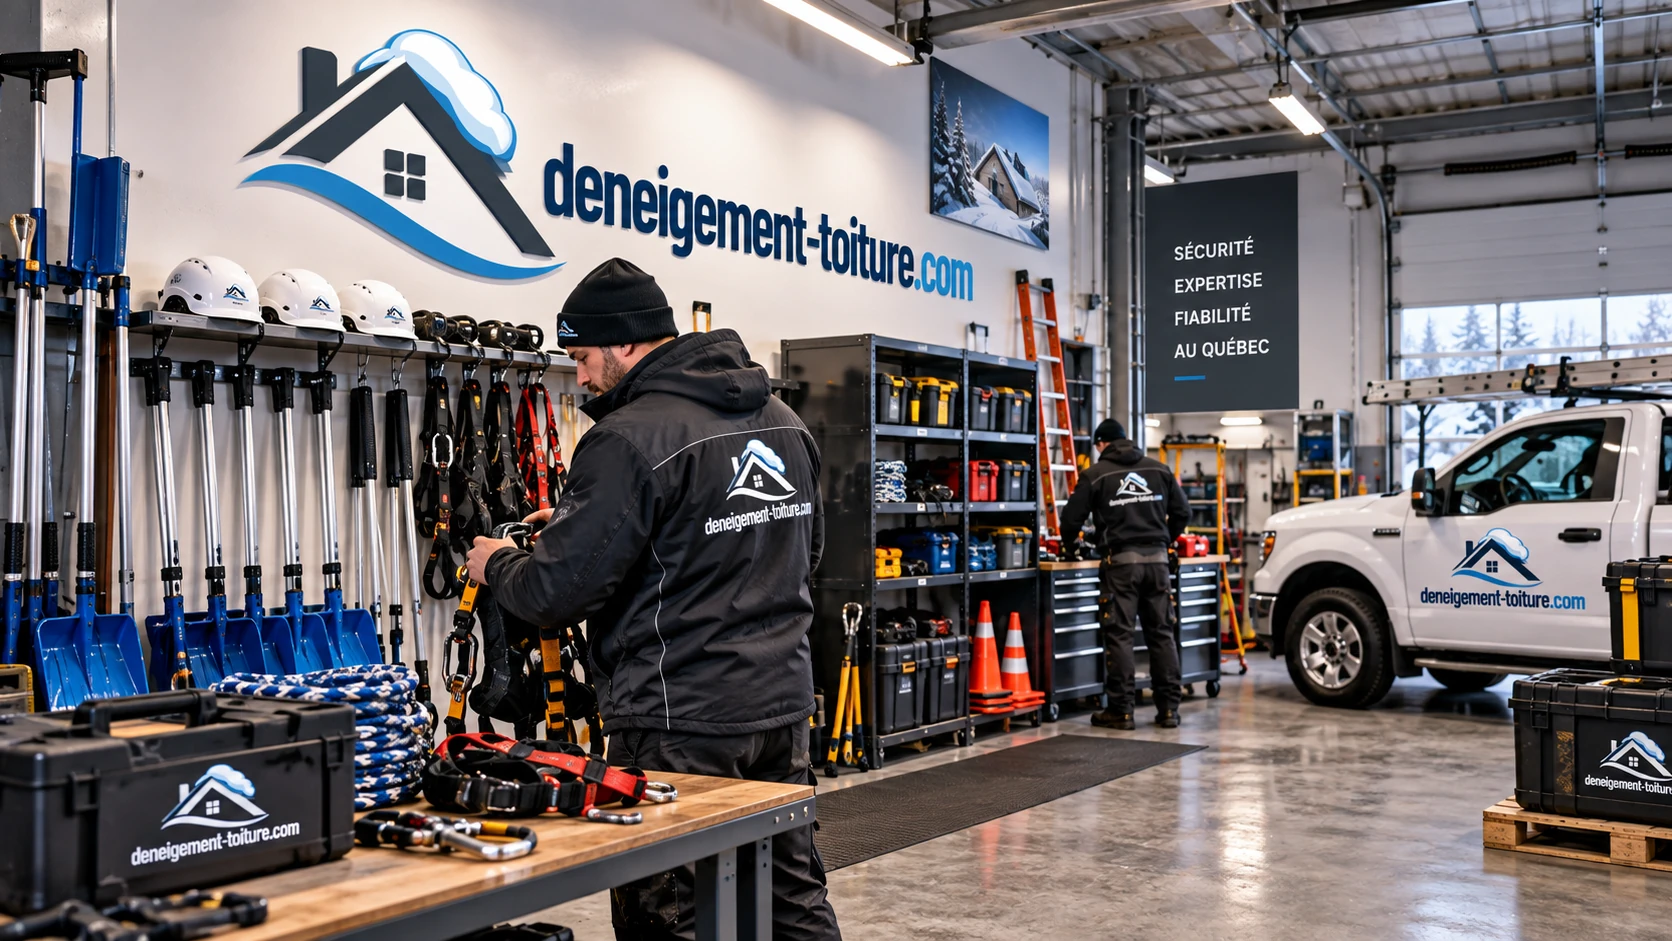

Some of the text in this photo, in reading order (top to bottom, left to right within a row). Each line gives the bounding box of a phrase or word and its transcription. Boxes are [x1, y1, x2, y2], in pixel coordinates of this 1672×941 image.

[543, 142, 974, 301] deneigement-toiture.com
[1174, 235, 1254, 261] SÉCURITÉ
[1174, 271, 1263, 294] EXPERTISE
[1174, 301, 1251, 326] FIABILITÉ
[1173, 336, 1270, 359] AU QUÉBEC
[1420, 587, 1586, 610] deneigement-toiture.com
[130, 822, 300, 866] deneigement-toiture.com
